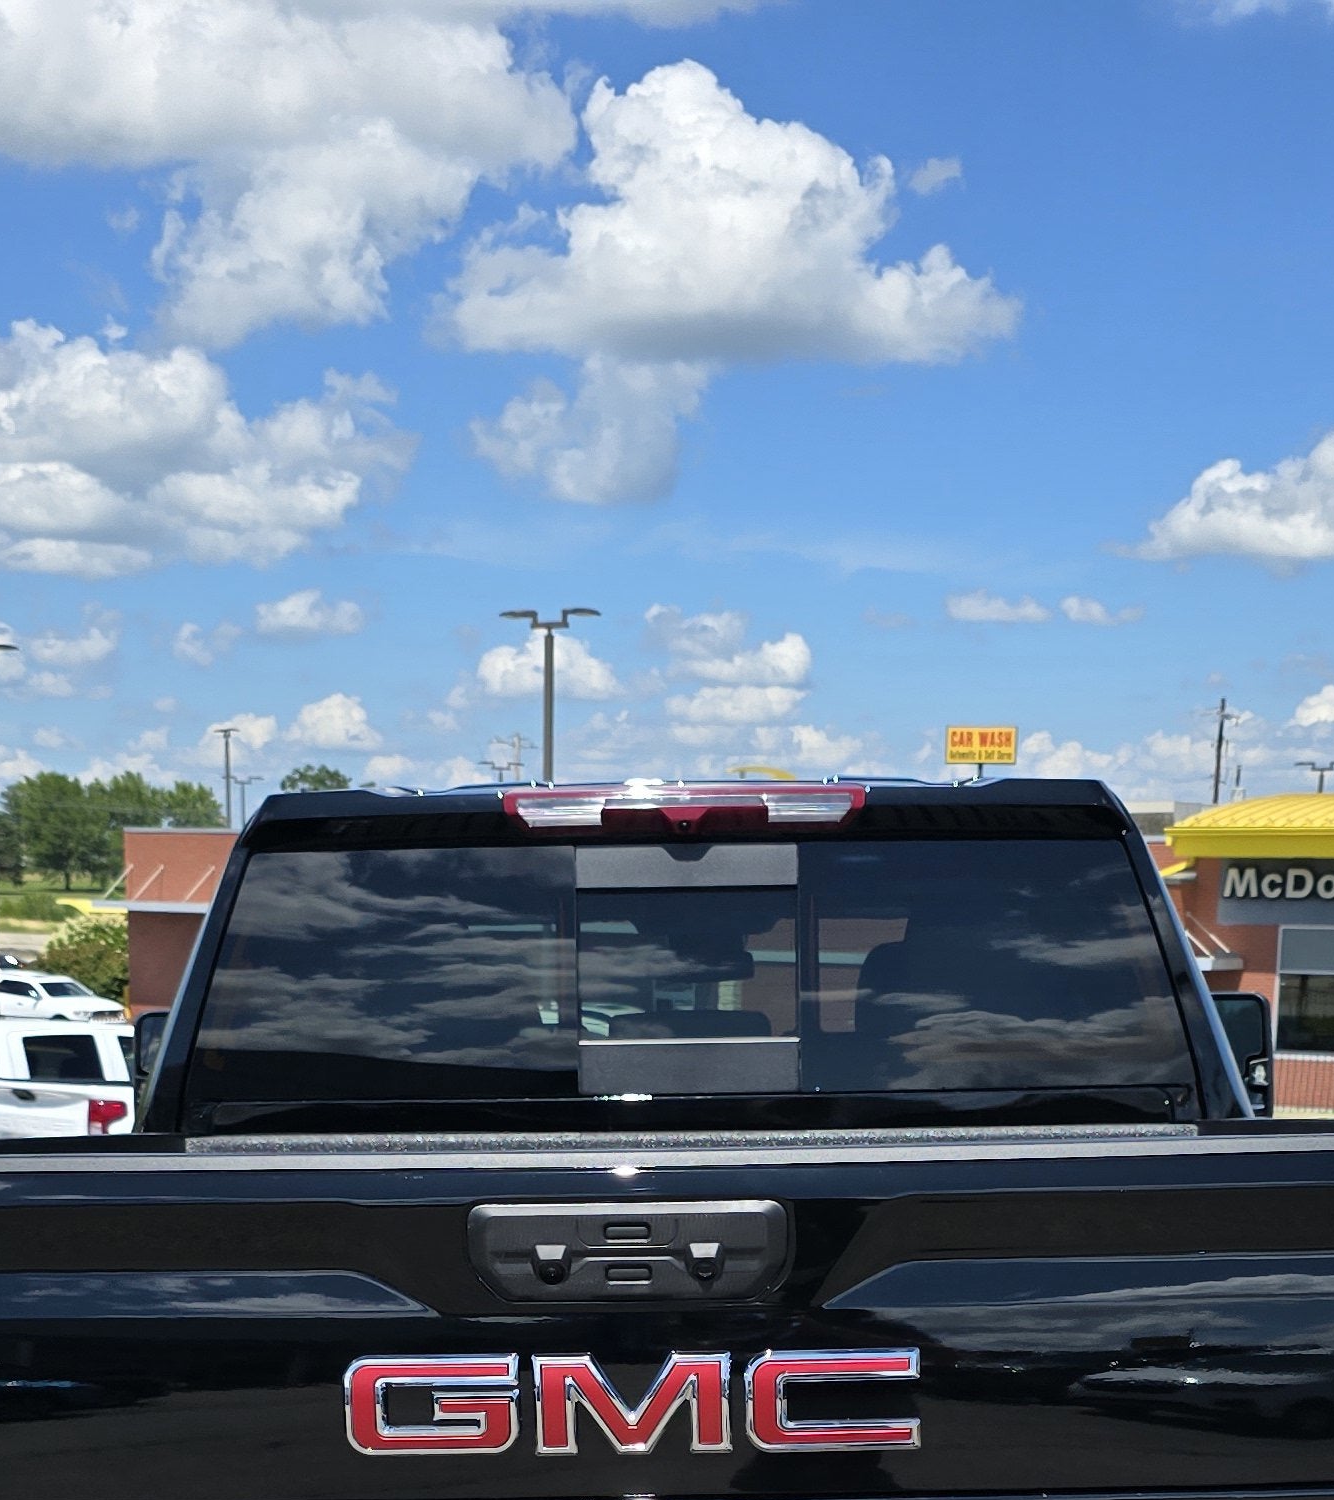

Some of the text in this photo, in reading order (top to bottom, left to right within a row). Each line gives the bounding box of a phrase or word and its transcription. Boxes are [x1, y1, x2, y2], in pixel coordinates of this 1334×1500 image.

[951, 731, 1012, 748] CAR WASH
[343, 1347, 921, 1456] GMC
